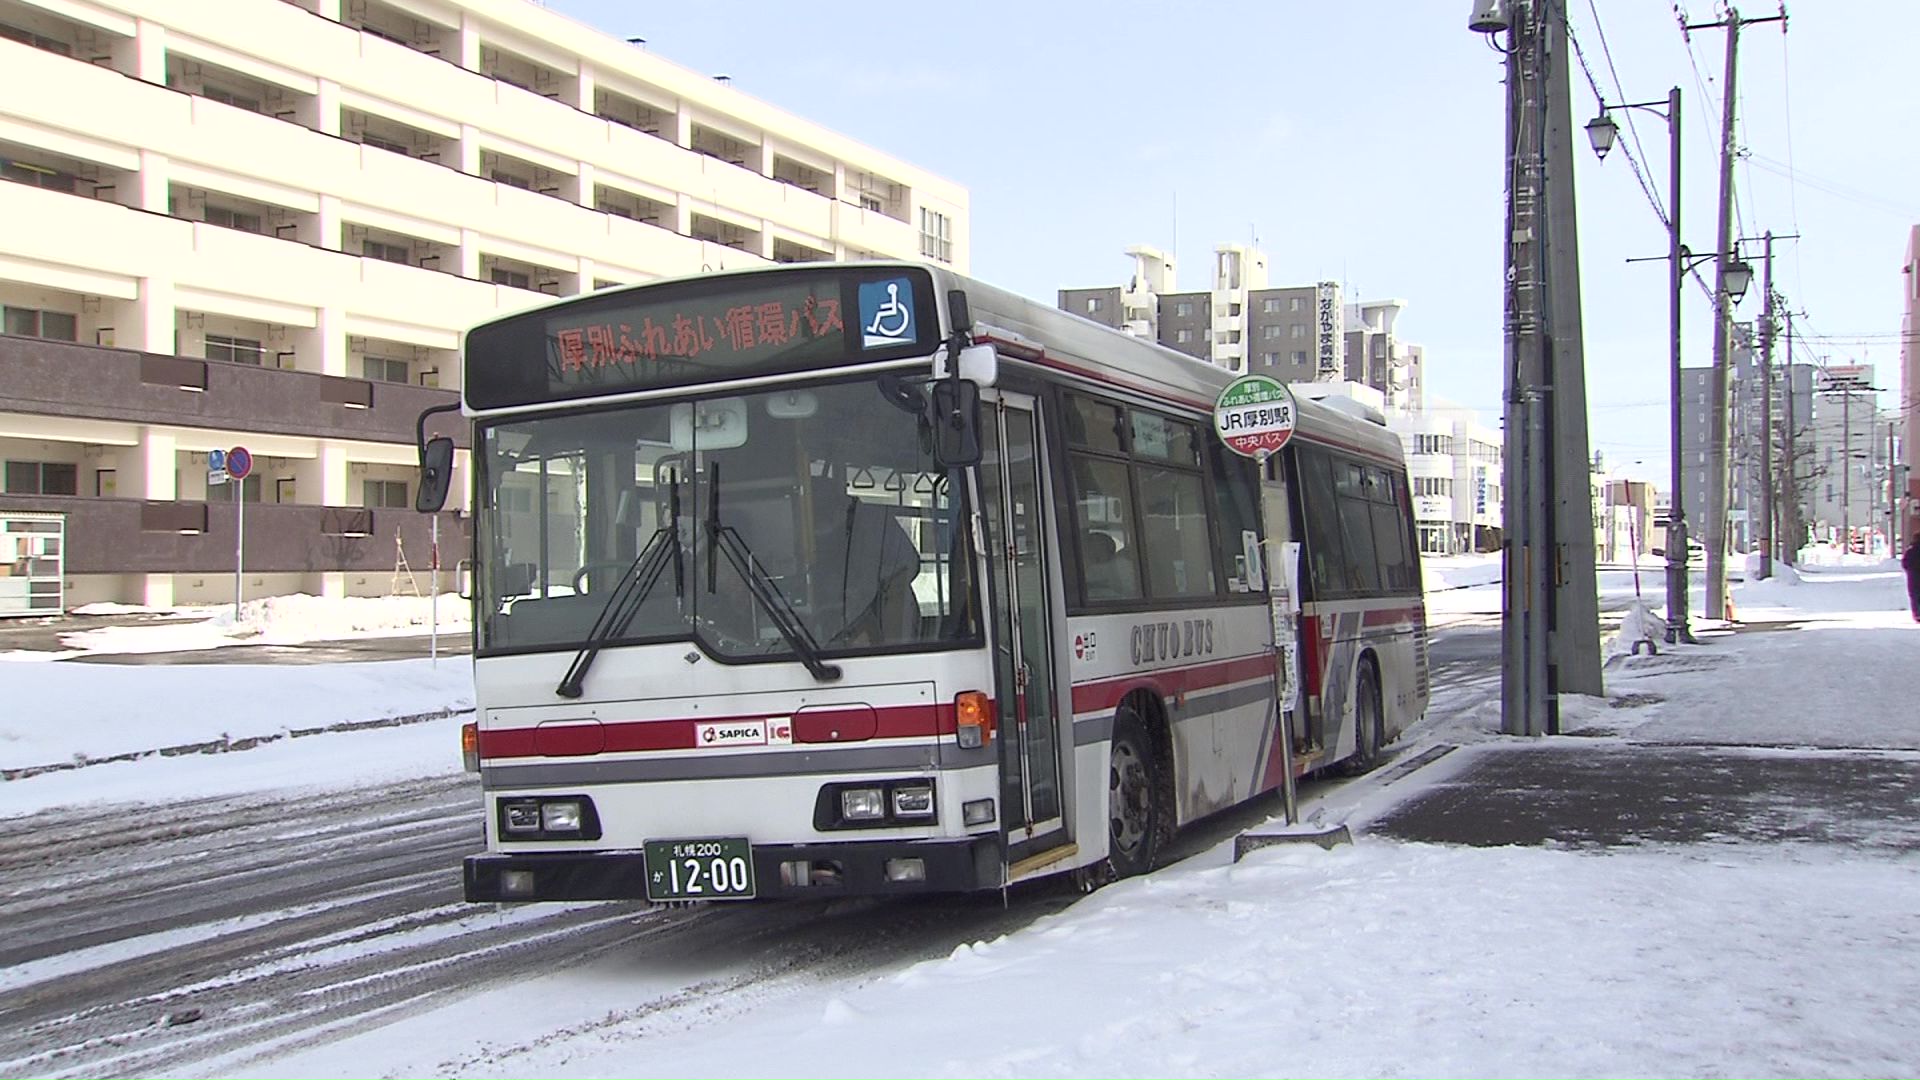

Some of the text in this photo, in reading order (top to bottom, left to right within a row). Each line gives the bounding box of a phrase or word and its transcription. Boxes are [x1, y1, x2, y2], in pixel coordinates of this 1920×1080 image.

[557, 296, 844, 372] 厚別ふれあい循環バス
[1220, 406, 1290, 430] JR厚別駅
[1235, 432, 1281, 448] 中央バス
[1130, 618, 1214, 666] CHUO BUS
[719, 728, 759, 739] SAPICA
